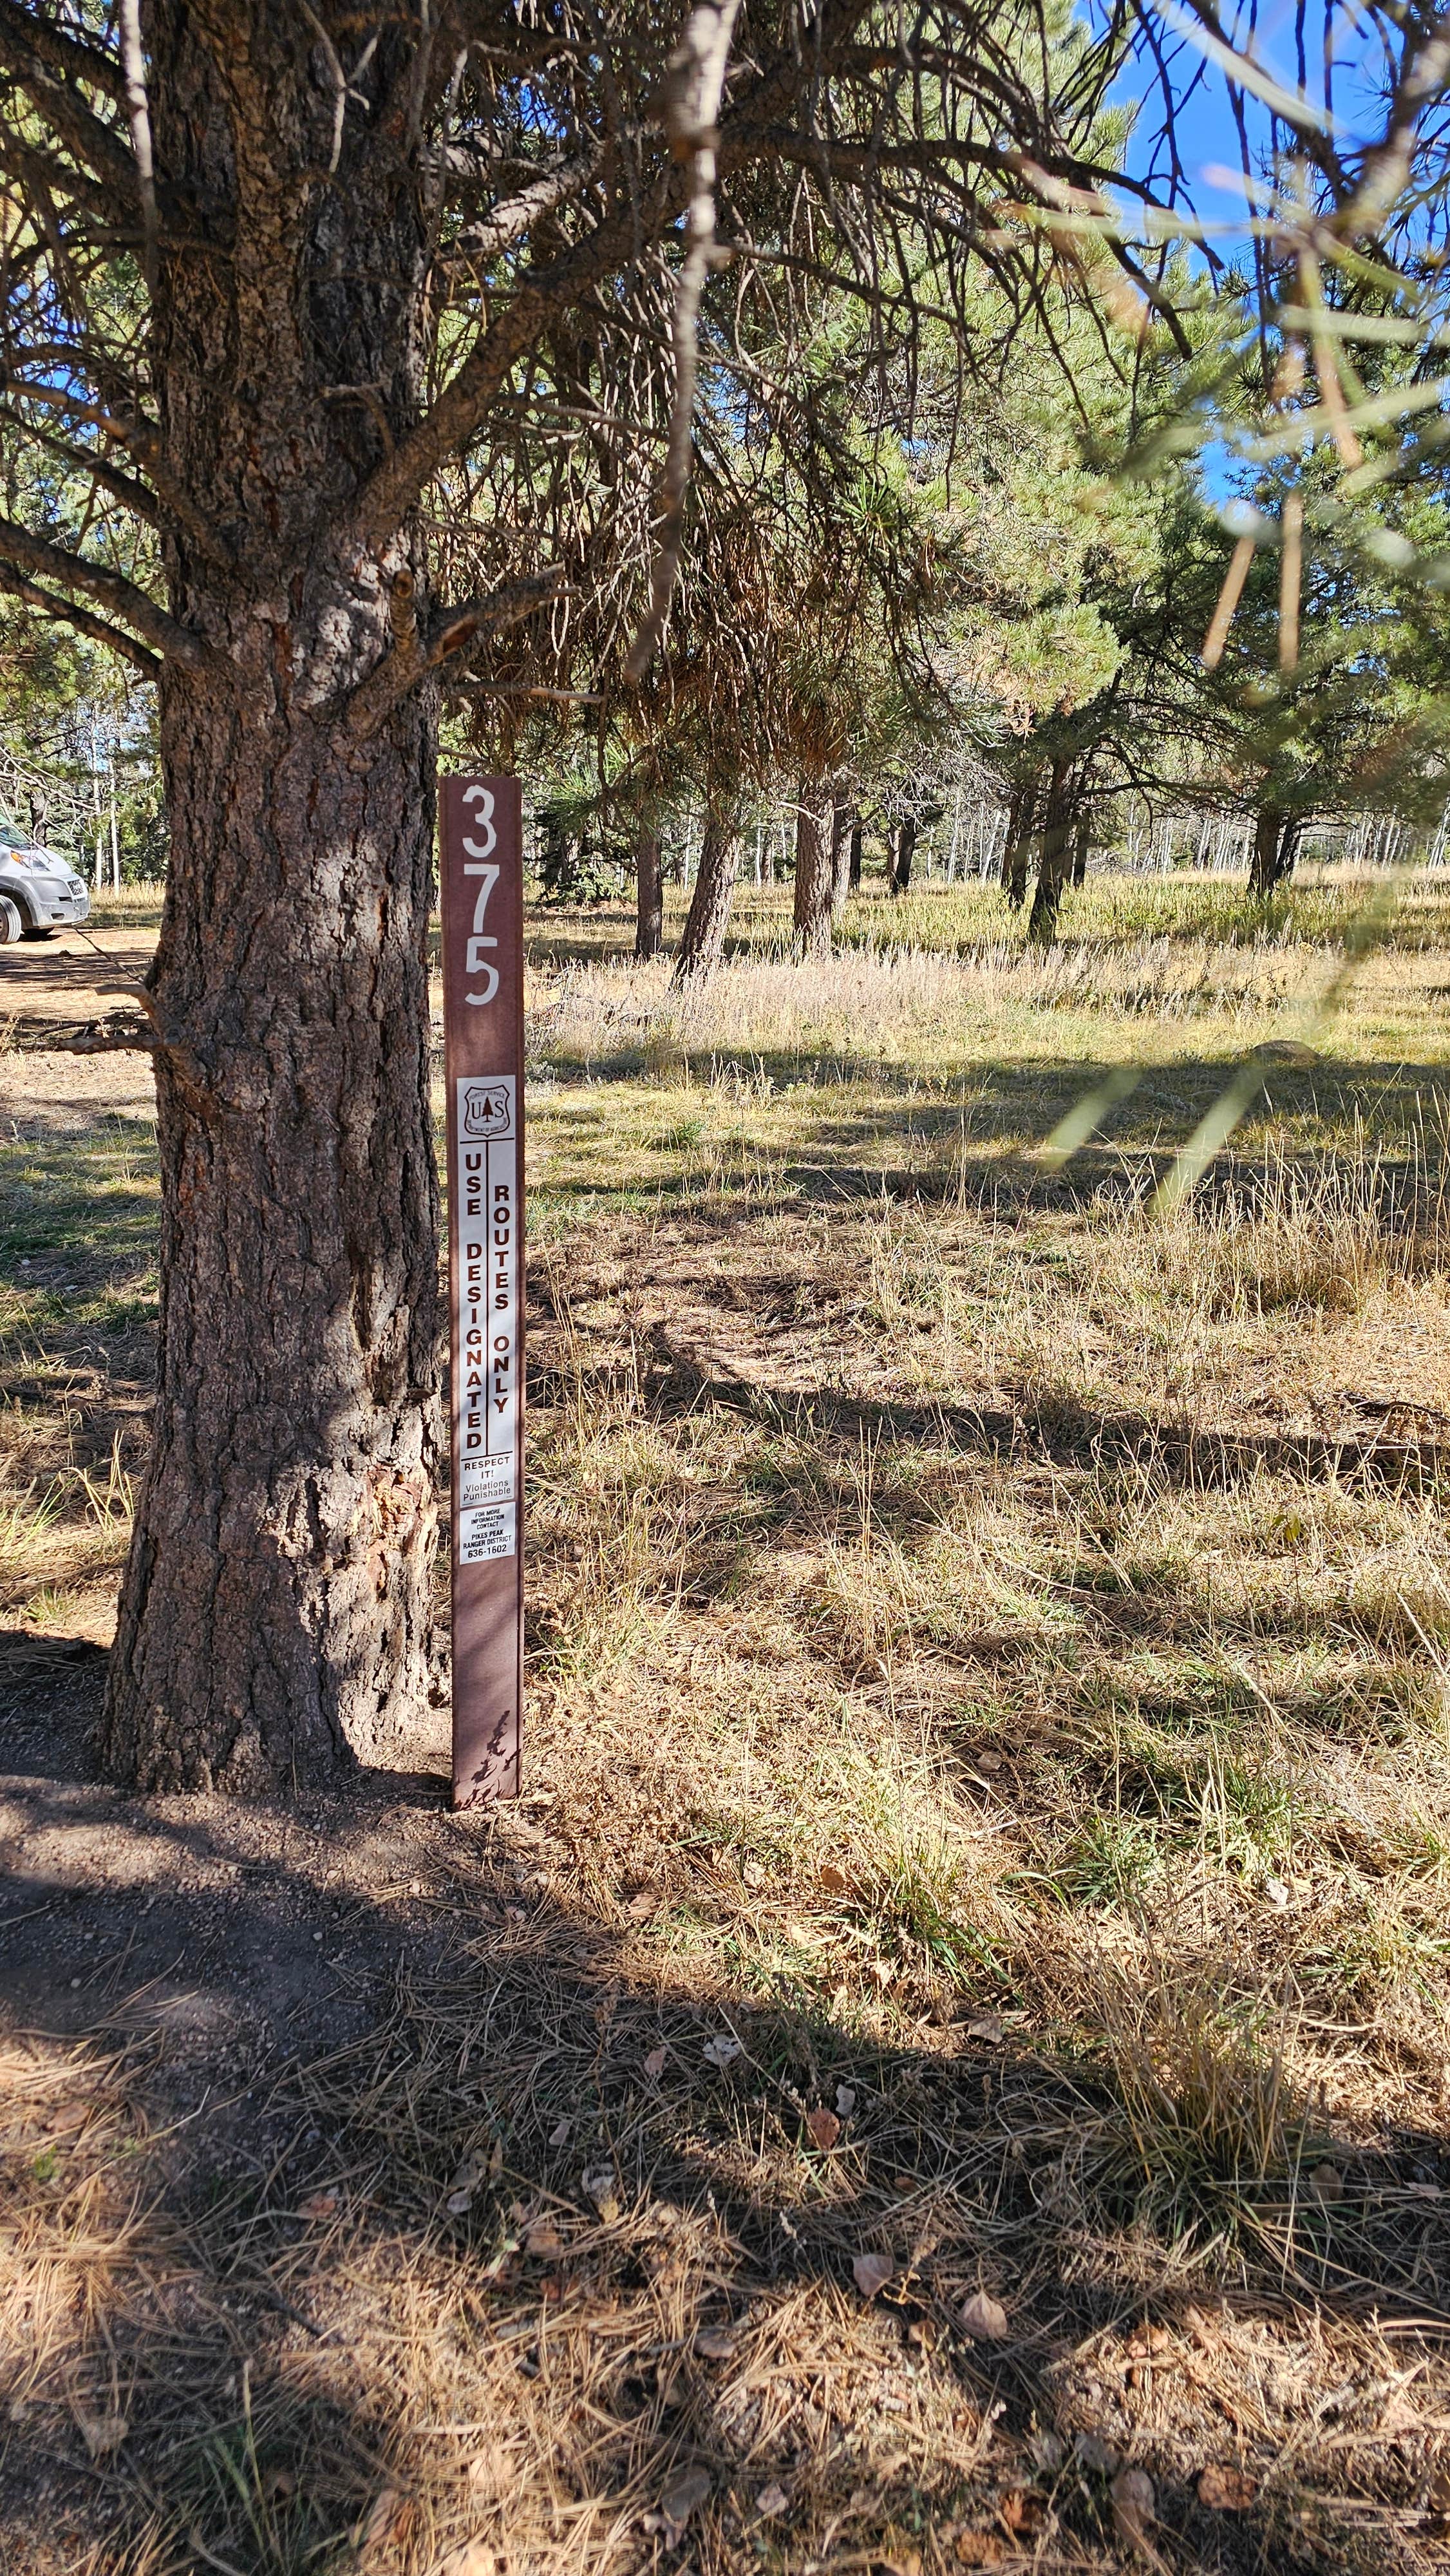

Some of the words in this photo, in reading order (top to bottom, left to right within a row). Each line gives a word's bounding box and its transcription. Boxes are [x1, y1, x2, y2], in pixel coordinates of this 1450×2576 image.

[462, 784, 500, 1005] 375
[466, 1153, 482, 1216] USE
[494, 1185, 510, 1310] ROUTES
[466, 1243, 483, 1449] DESIGNATED
[493, 1336, 509, 1414] ONLY
[464, 1457, 510, 1471] RESPECT
[481, 1470, 494, 1479] IT!
[466, 1480, 509, 1493] Violations
[464, 1487, 511, 1501] Punishable
[471, 1514, 505, 1524] INFORMATION
[476, 1521, 499, 1530] CONTACT
[471, 1532, 488, 1540] PIKES
[489, 1529, 504, 1537] PEAK
[463, 1540, 485, 1549] RANGER
[487, 1535, 511, 1545] DISTRICT
[468, 1544, 507, 1558] 636-1602
